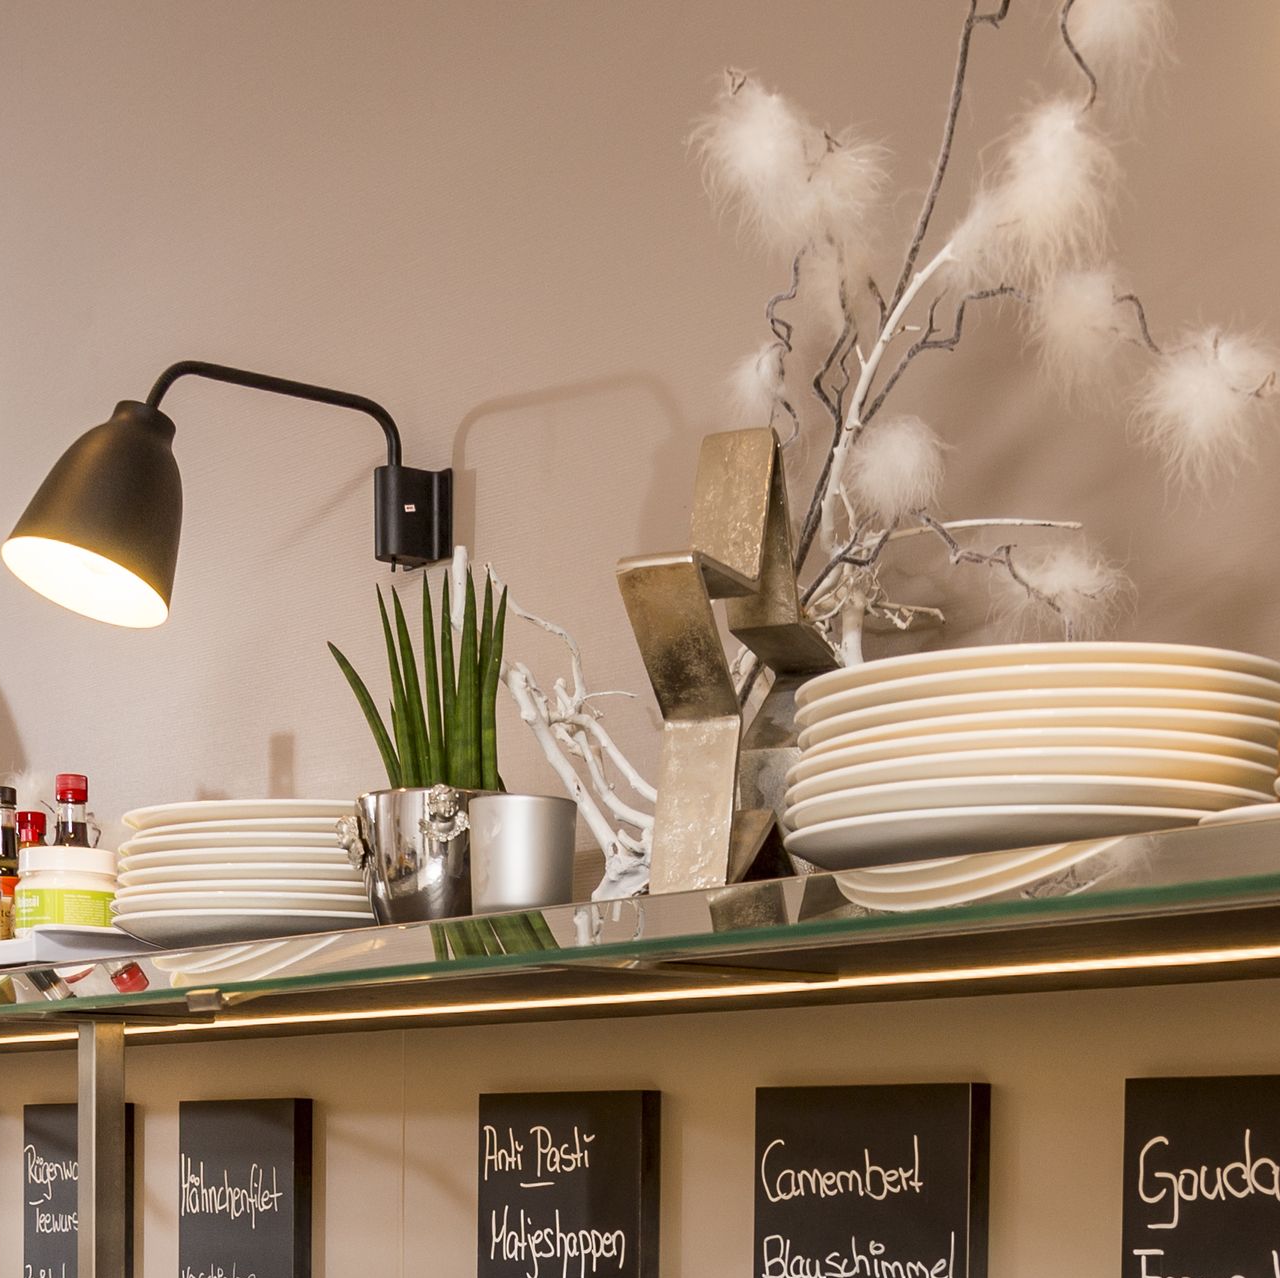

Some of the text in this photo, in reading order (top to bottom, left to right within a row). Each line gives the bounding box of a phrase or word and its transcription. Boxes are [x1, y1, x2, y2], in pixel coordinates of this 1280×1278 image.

[483, 1126, 595, 1181] Anti Pasti
[761, 1135, 923, 1202] Camembert
[28, 1199, 78, 1233] Teewurs
[181, 1153, 283, 1229] Hähnchenfilet
